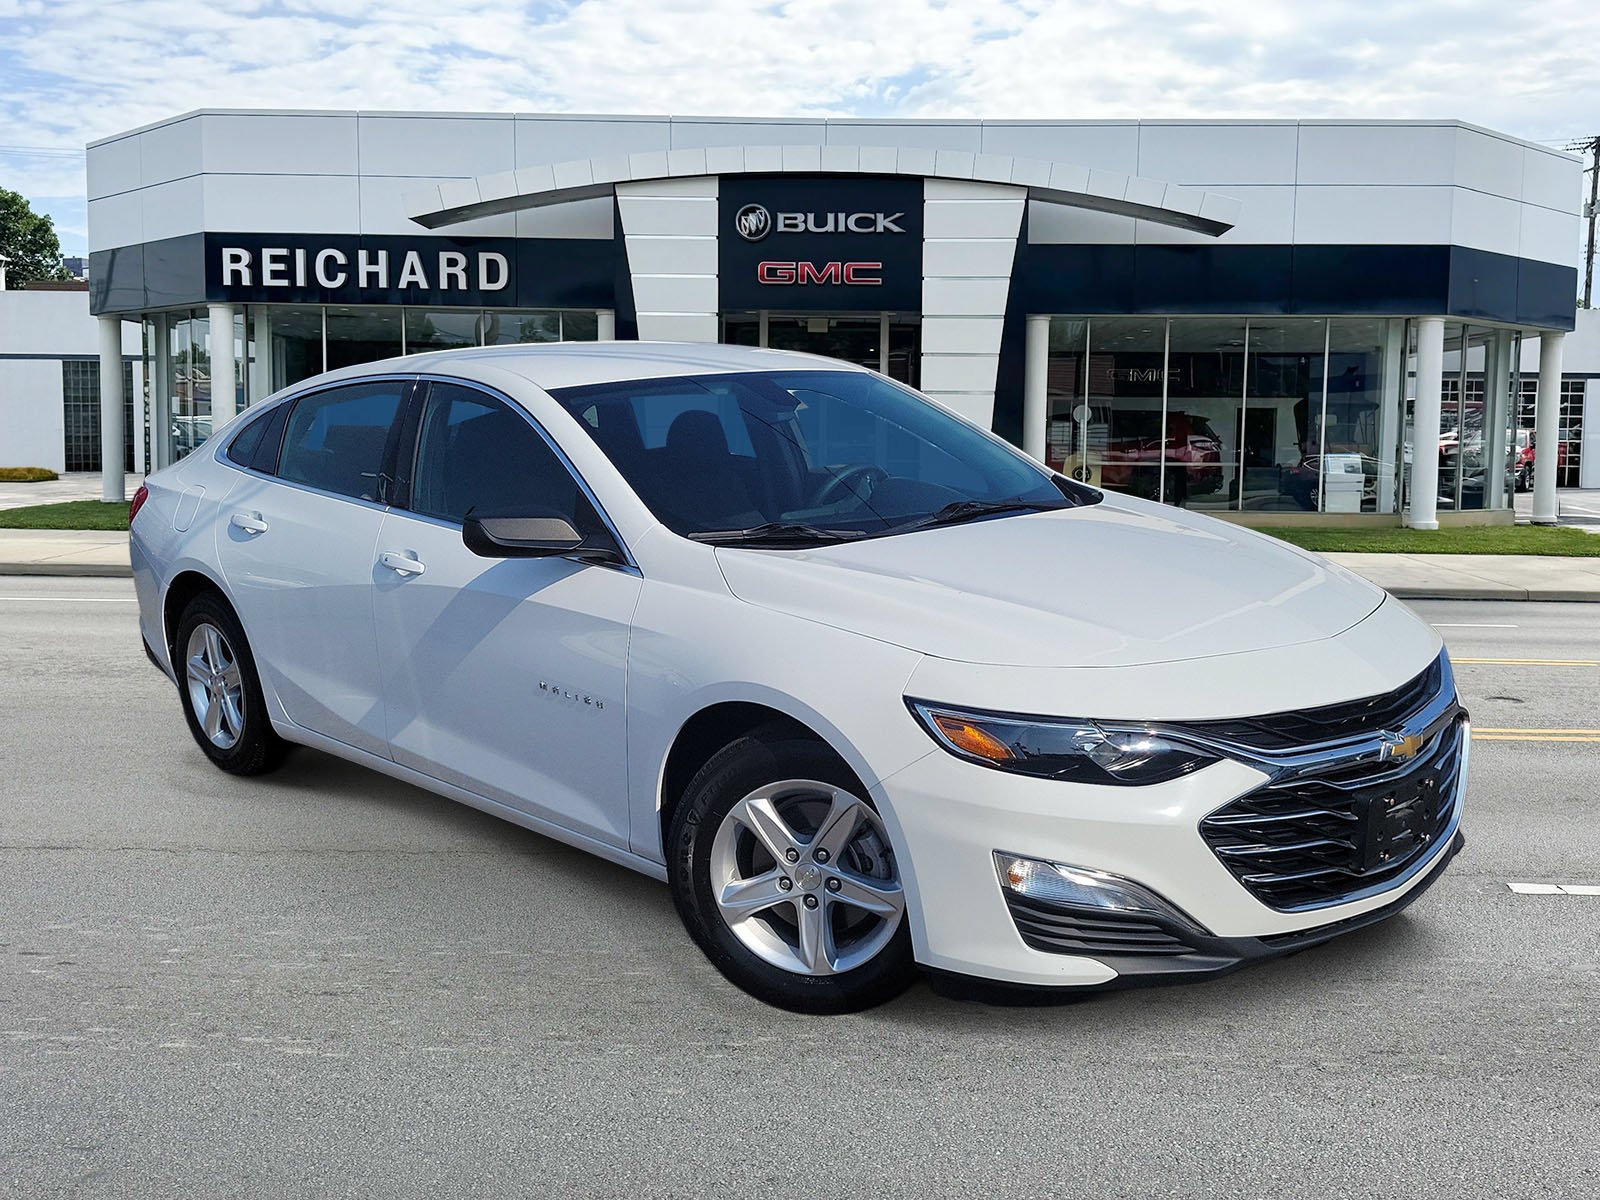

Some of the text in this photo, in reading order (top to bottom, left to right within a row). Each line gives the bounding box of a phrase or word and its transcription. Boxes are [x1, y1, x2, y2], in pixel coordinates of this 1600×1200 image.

[776, 212, 906, 233] BUICK
[221, 247, 509, 291] REICHARD
[757, 261, 883, 285] GMC
[539, 680, 604, 709] MALIBU
